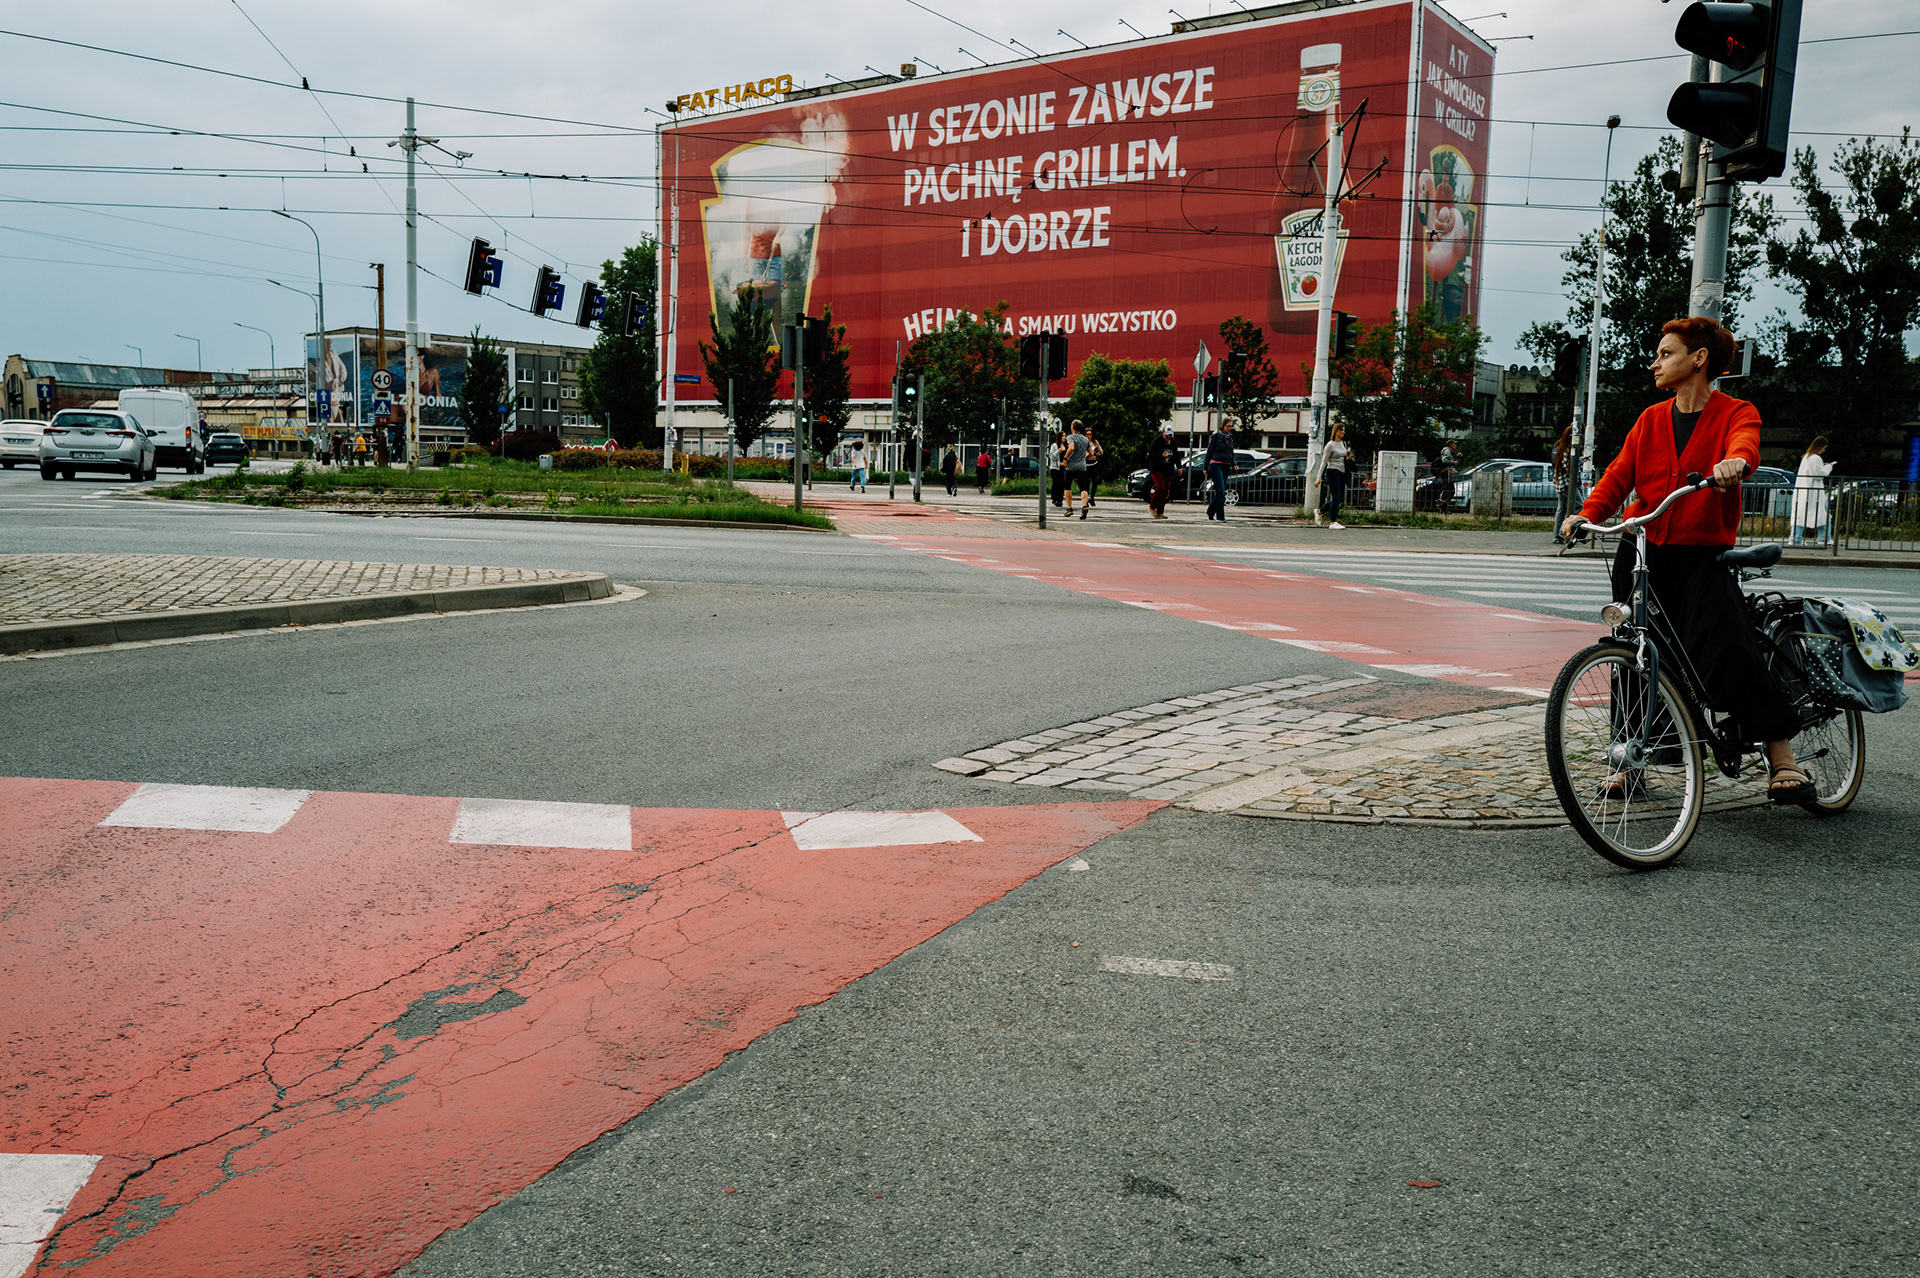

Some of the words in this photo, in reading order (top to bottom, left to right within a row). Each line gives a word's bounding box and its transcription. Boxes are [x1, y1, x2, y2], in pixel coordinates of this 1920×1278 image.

[1449, 44, 1455, 68] A
[1458, 49, 1468, 75] TY
[677, 88, 719, 113] FAT
[724, 74, 793, 105] HACO
[1311, 90, 1327, 102] 57
[1427, 61, 1442, 92] JAK
[1444, 71, 1485, 118] DMUCHASZ
[887, 112, 918, 152] W
[928, 91, 1056, 147] SEZONIE
[1067, 66, 1215, 128] ZAWSZE
[1435, 98, 1445, 123] W
[1445, 106, 1476, 142] GRILLA?
[904, 155, 1023, 206] PACHNĘ
[1034, 135, 1187, 192] GRILLEM.
[961, 219, 970, 257] I
[980, 206, 1111, 256] DOBRZE
[1293, 219, 1325, 233] HEIN
[1287, 242, 1322, 255] KETCH
[1289, 256, 1323, 267] ŁAGODN
[903, 308, 978, 341] HEIN
[1018, 313, 1077, 336] SMAKU
[1082, 309, 1177, 333] WSZYSTKO
[374, 375, 391, 385] 40
[309, 391, 353, 402] CDONIA
[320, 403, 328, 413] P
[371, 393, 459, 408] LZDONIA
